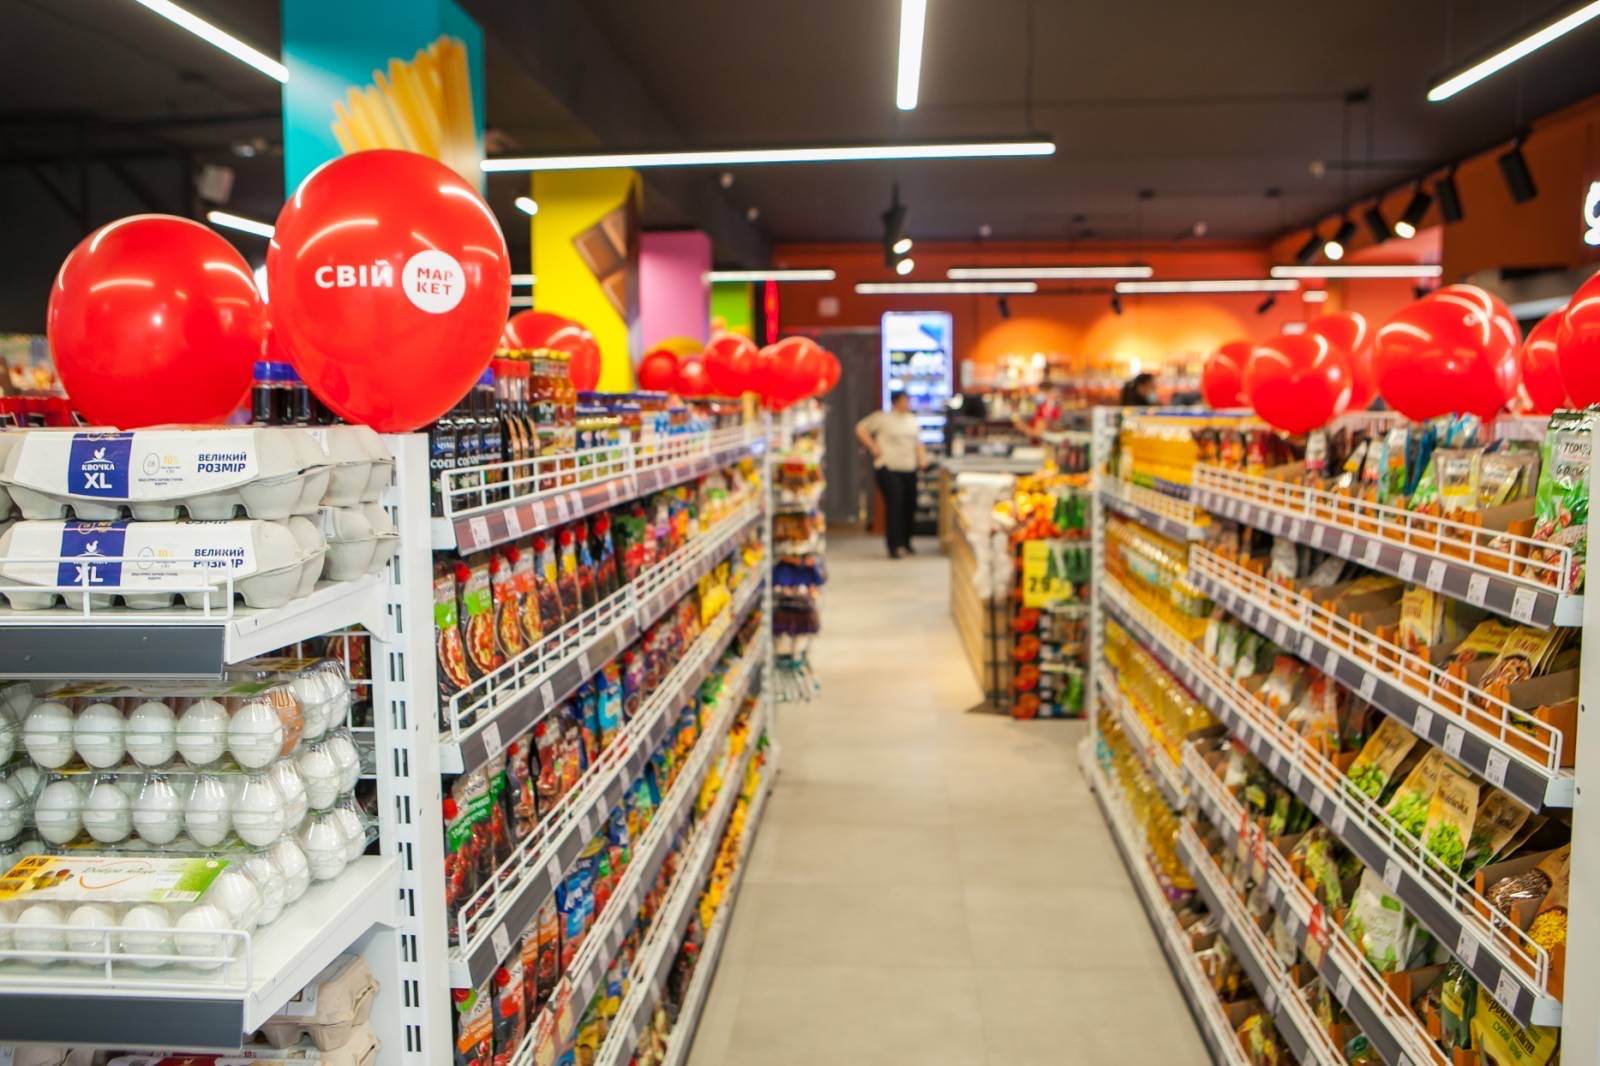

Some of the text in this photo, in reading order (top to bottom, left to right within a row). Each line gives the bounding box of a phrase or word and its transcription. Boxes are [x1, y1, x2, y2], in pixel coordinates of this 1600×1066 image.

[314, 259, 393, 288] СВІЙ
[198, 451, 247, 461] ВЕЛИКИЙ
[81, 463, 115, 471] КВОЧКА
[197, 463, 246, 473] РОЗМІР
[84, 472, 112, 489] XL
[194, 547, 245, 557] ВЕЛИКИЙ
[193, 558, 244, 568] РЗМІР
